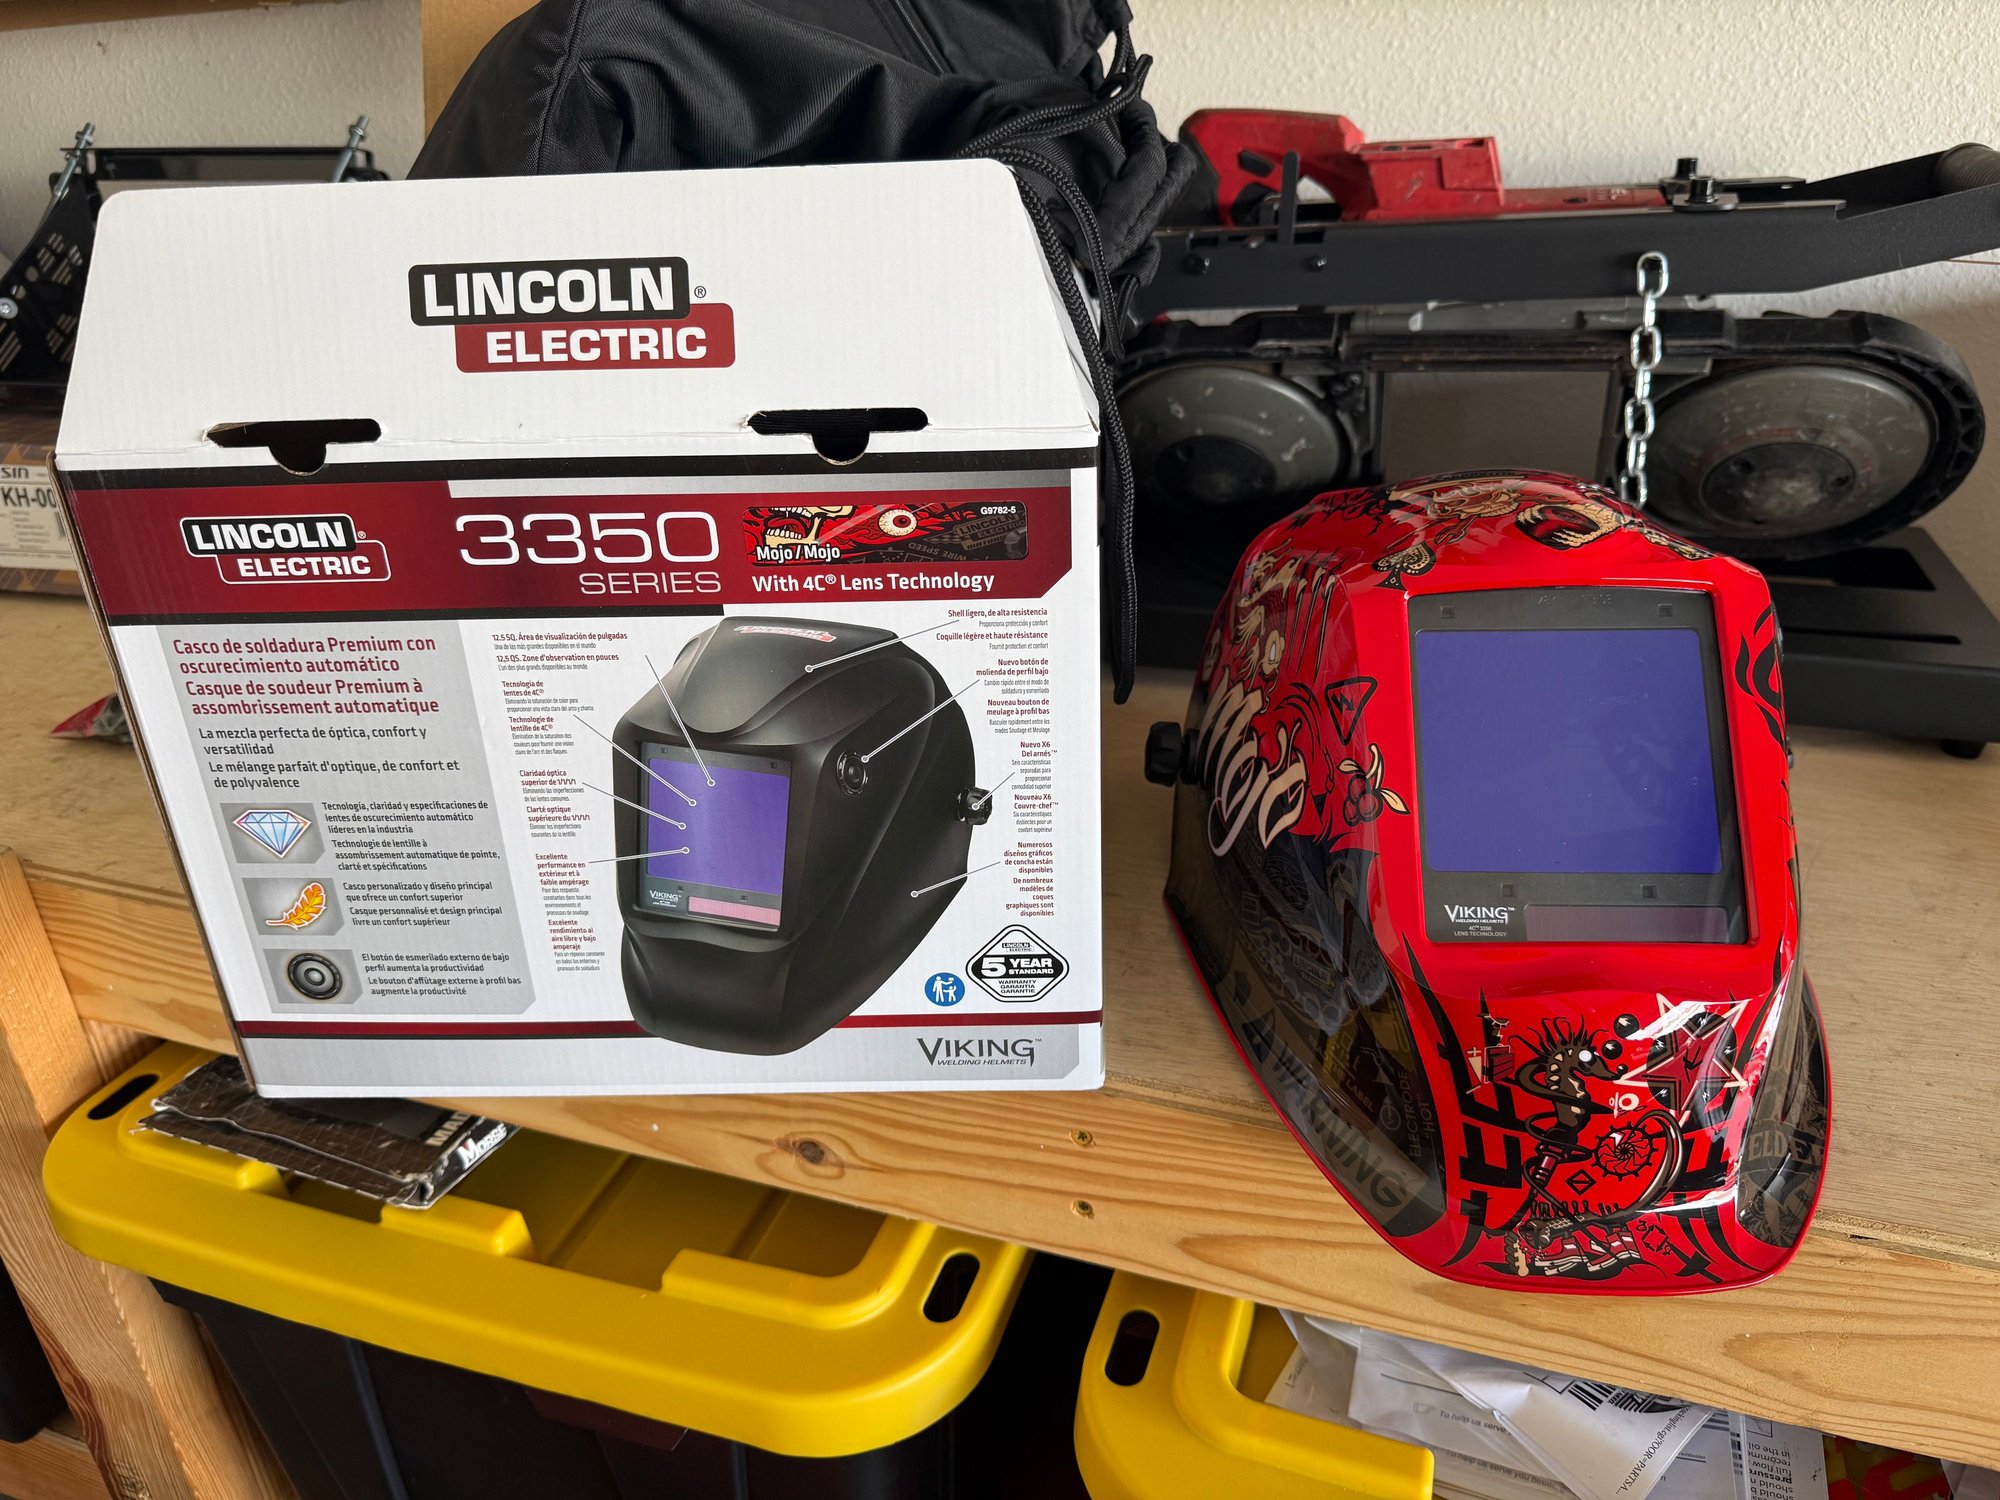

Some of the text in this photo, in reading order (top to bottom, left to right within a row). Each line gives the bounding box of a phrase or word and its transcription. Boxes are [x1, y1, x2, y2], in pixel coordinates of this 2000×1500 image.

[423, 267, 674, 317] LINCOLN
[486, 326, 707, 364] ELECTRIC
[980, 505, 1017, 516] G9782-5
[192, 521, 347, 550] LINCOLN
[455, 511, 720, 566] 3350
[756, 546, 794, 566] Mojo
[804, 545, 841, 564] Mojo
[908, 541, 941, 557] SPEED
[237, 555, 371, 577] ELECTRIC
[578, 571, 722, 595] SERIES
[752, 574, 799, 592] With
[841, 574, 884, 591] Lens
[886, 571, 995, 593] Technology
[948, 609, 964, 617] Shell
[965, 608, 987, 618] ligero,
[1010, 607, 1047, 616] resistencia
[543, 632, 587, 640] visualización
[588, 632, 596, 640] de
[597, 631, 627, 641] pulgadas
[173, 635, 436, 654] Casco de soldadura Premium con
[179, 655, 399, 674] oscurecimiento automático
[185, 677, 423, 699] Casque de soudeur Premium à
[192, 697, 439, 716] assombrissement automatique
[198, 725, 426, 741] La mezcla perfecta de óptica, confort y
[203, 742, 274, 754] versatilidad
[208, 759, 460, 775] Le mélange parfait d'optique, de confort et
[546, 768, 567, 777] óptica
[214, 776, 300, 790] de polyvalence
[521, 778, 548, 787] superior
[321, 800, 488, 812] Tecnología, claridad y especificaciones de
[324, 812, 473, 822] lentes de oscurecimiento automático
[367, 825, 376, 833] la
[376, 824, 413, 833] industria
[342, 881, 493, 891] Casco personalizado y diseño principal
[349, 906, 378, 916] Casque
[378, 906, 429, 916] personnalisé
[439, 906, 466, 916] design
[467, 905, 502, 916] principal
[370, 953, 394, 961] botón
[394, 953, 404, 961] de
[405, 952, 448, 961] esmerilado
[491, 952, 509, 962] bajo
[981, 957, 1053, 978] 5 YEAR
[485, 976, 506, 986] profil
[1273, 1041, 1407, 1209] WARNING
[1483, 1422, 1506, 1433] serve
[1762, 1446, 1778, 1456] the
[1752, 1461, 1791, 1477] full flow
[1760, 1480, 1794, 1494] should
